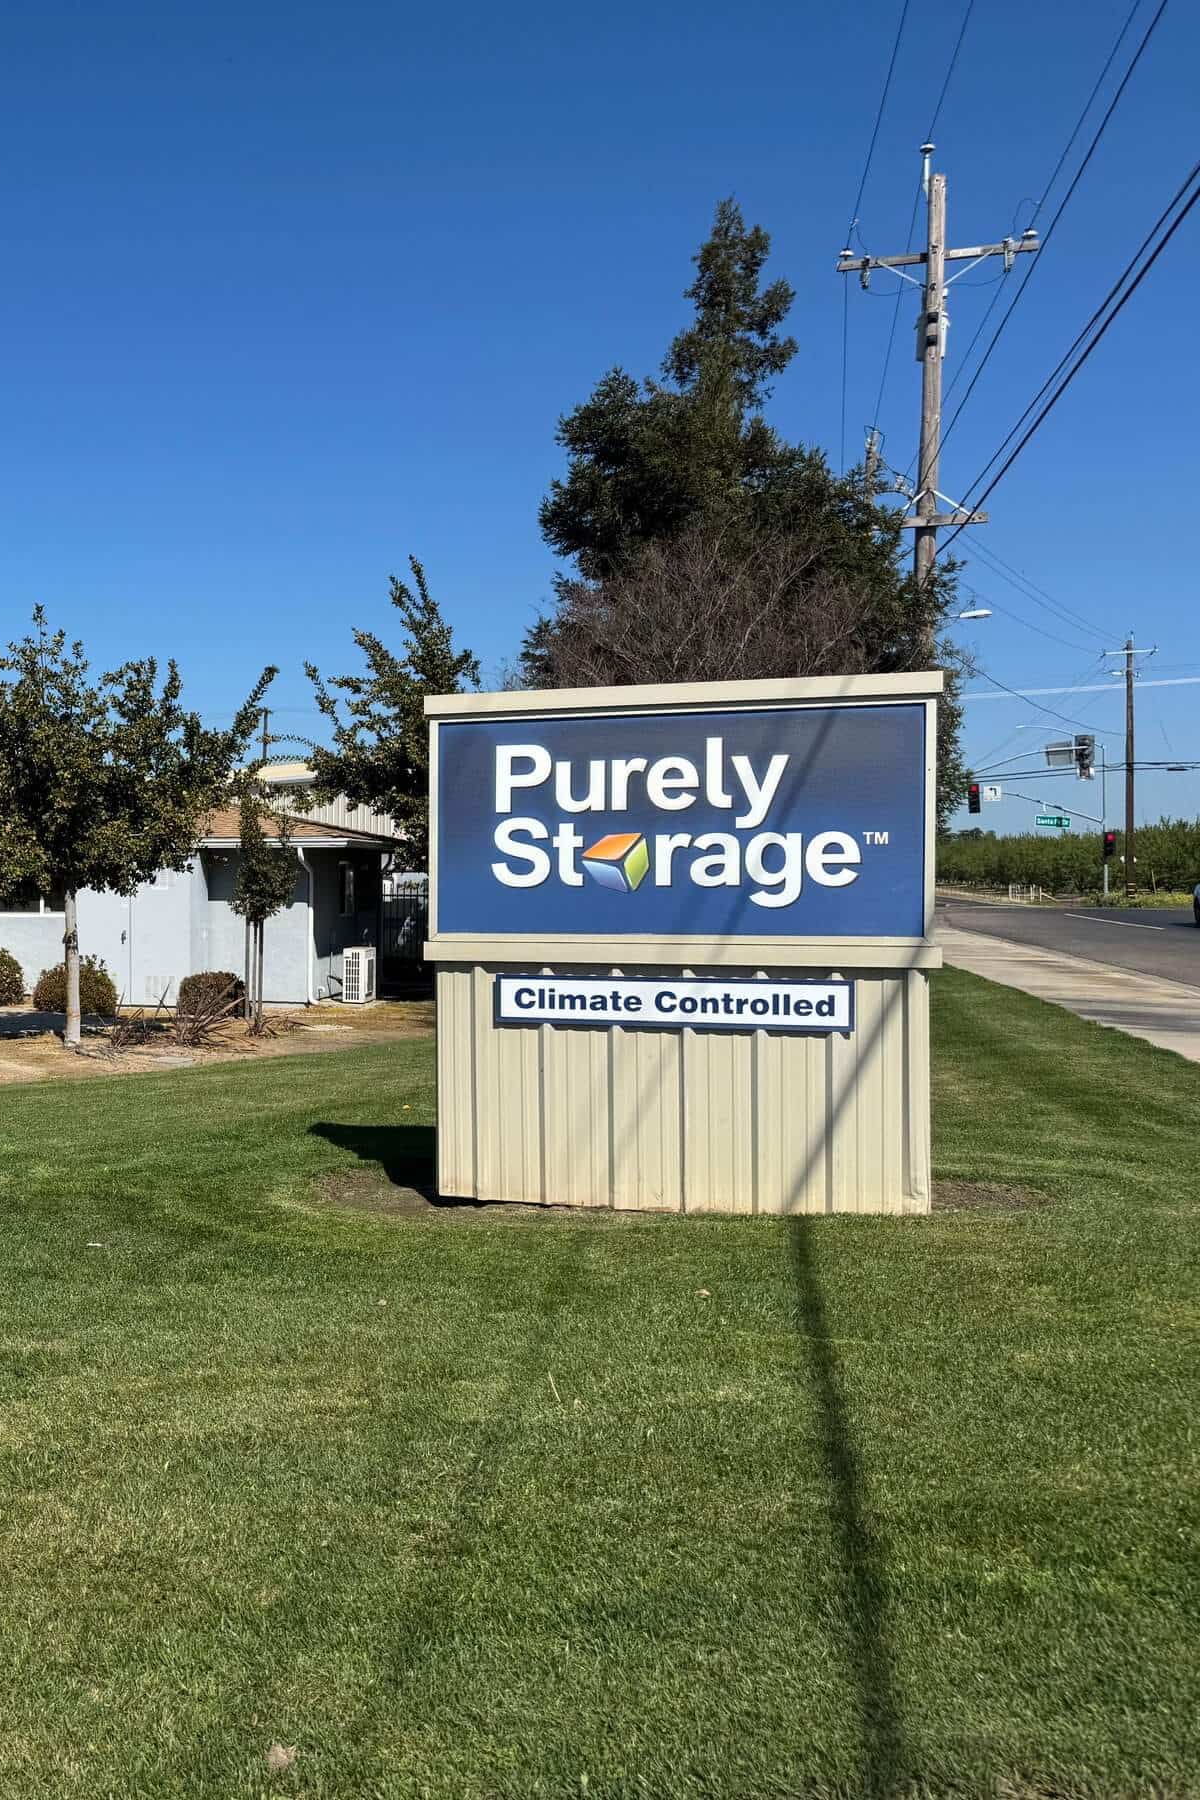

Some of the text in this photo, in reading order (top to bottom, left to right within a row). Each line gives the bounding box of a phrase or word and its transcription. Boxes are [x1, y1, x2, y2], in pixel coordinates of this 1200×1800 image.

[495, 737, 790, 829] Purely
[492, 816, 862, 908] Strage
[514, 987, 836, 1017] Climate Controlled
